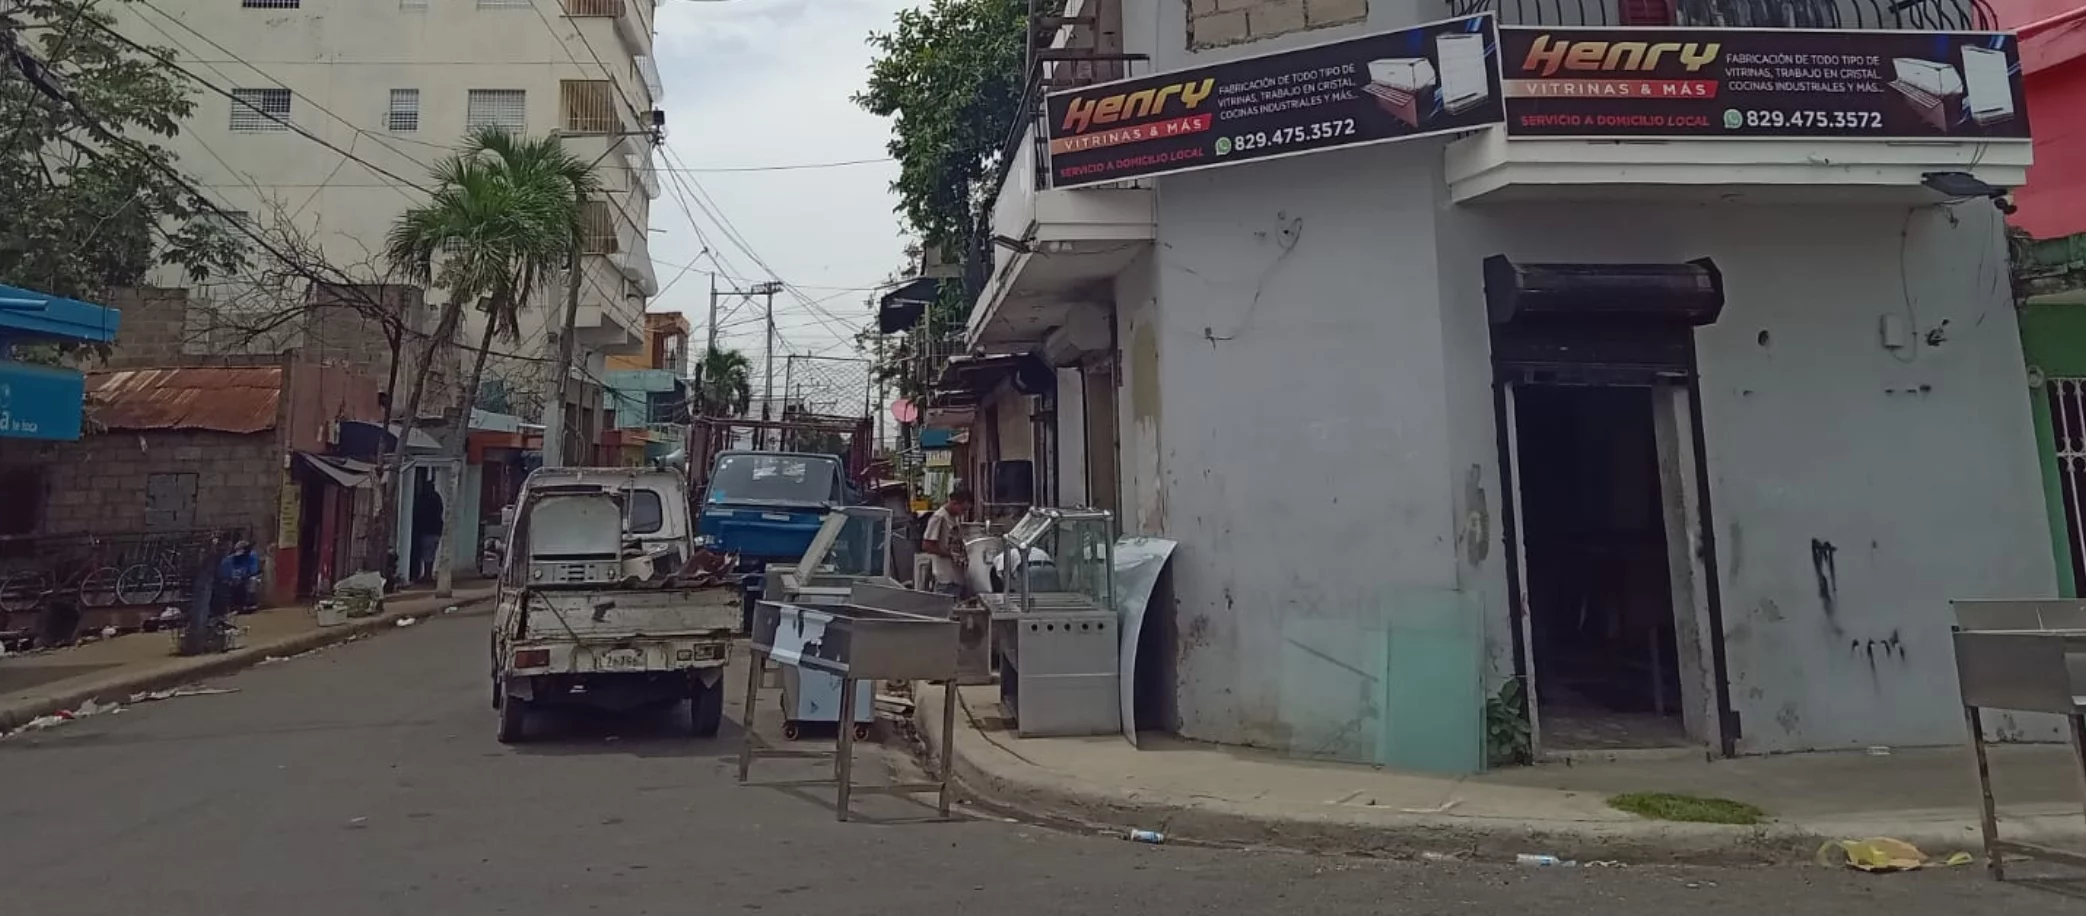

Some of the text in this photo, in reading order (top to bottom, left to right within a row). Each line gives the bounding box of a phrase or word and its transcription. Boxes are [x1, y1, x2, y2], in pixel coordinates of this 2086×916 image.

[1522, 34, 1721, 77] Henry
[1725, 53, 1880, 66] FABRICACIÓN DE TODO TIPO DE
[1218, 63, 1355, 95] FABRICACIÓN DE TODO TIPO DE
[1776, 68, 1821, 78] TRABAJO
[1824, 68, 1838, 78] EN
[1260, 87, 1301, 101] TRABAJO
[1302, 83, 1316, 94] EN
[1526, 80, 1706, 96] VITRINAS & MÁS
[1728, 81, 1773, 91] COCINAS
[1775, 81, 1845, 92] INDUSTRIALES
[1847, 82, 1855, 92] Y
[1062, 78, 1215, 133] Henry
[1220, 105, 1258, 120] COCINAS
[1259, 94, 1323, 114] INDUSTRIALES
[1324, 93, 1331, 103] Y
[1521, 115, 1710, 126] SERVICIO A DOMICILIO LOCAL
[1746, 110, 1883, 128] 829.475.3572
[1064, 117, 1202, 150] VITRINAS & MÁS
[1234, 118, 1356, 151] 829.475.3572
[1060, 147, 1205, 178] SERVICIO A DOMICILIO LOCAL
